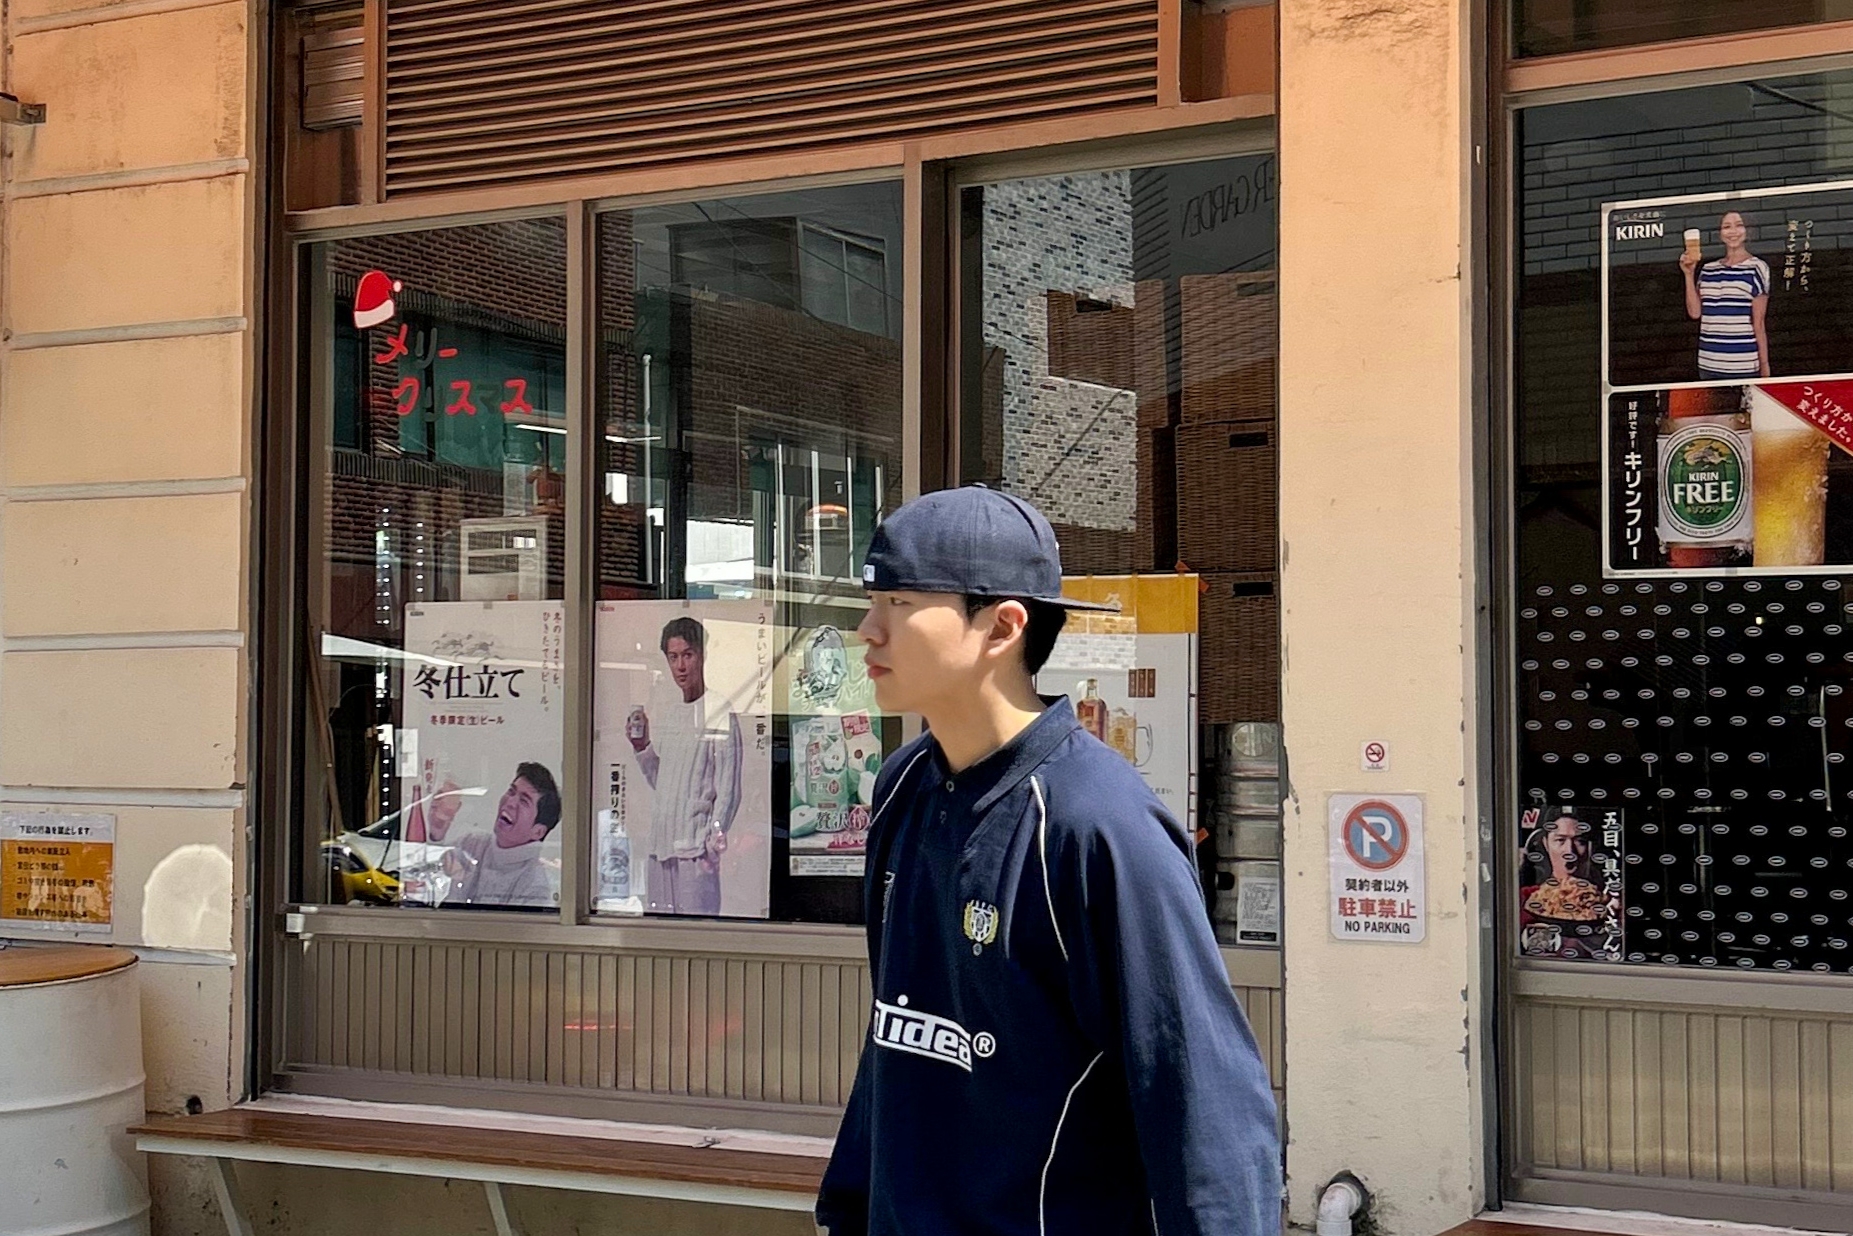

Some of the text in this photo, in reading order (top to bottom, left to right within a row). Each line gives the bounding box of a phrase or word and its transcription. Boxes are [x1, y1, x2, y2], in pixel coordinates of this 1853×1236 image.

[1616, 223, 1663, 240] KIRIN
[1688, 471, 1719, 482] KIRIN
[1673, 481, 1735, 504] FREE
[1624, 452, 1642, 560] キリンフリー
[413, 664, 525, 700] 冬仕立て
[1345, 878, 1409, 893] 契約者以外
[1338, 897, 1417, 919] 駐車禁止
[1345, 921, 1410, 934] NO PARKING
